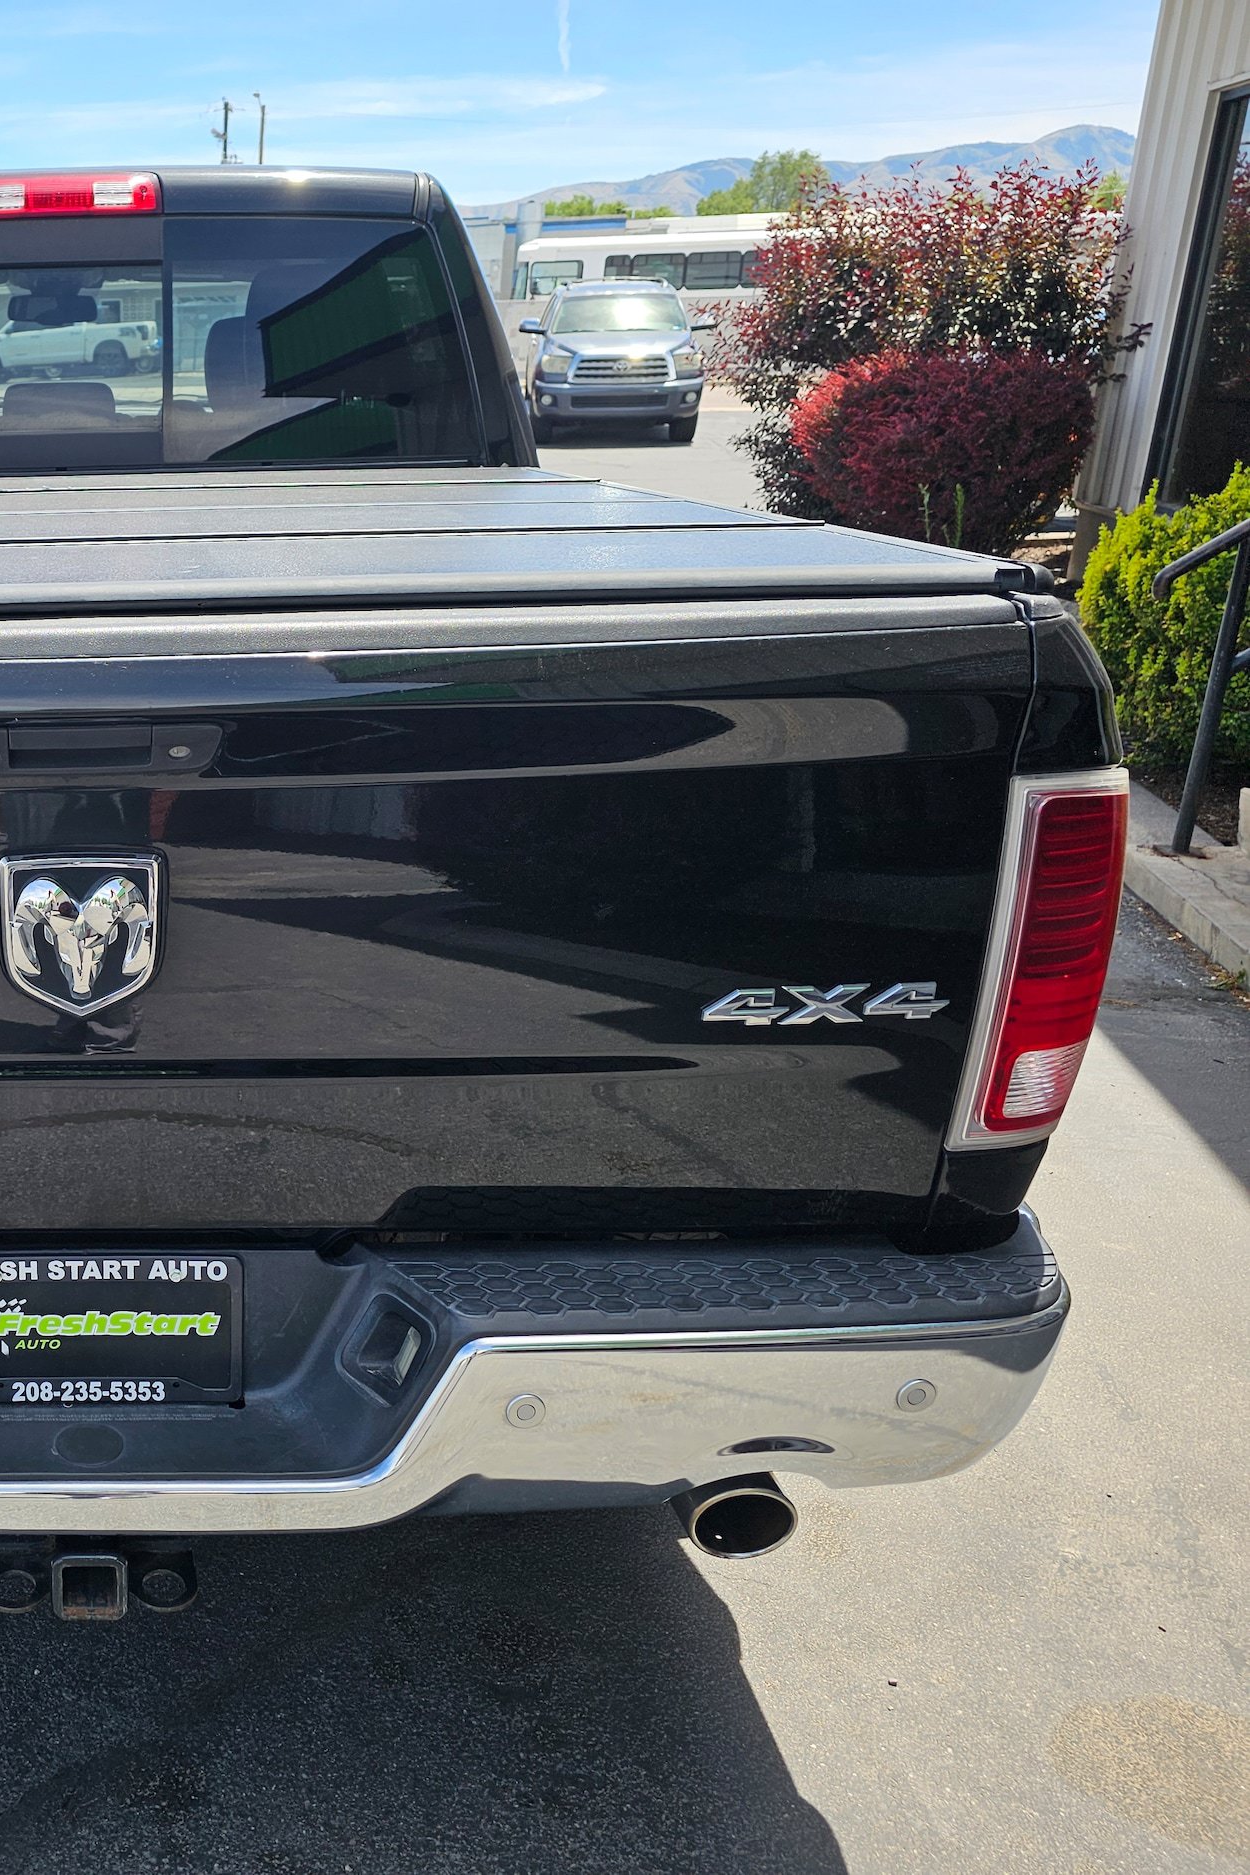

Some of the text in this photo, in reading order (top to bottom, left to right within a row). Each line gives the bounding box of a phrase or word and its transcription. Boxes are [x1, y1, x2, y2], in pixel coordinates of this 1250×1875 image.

[47, 1260, 140, 1281] START
[148, 1260, 228, 1282] AUTO
[15, 1339, 62, 1350] AUTO
[11, 1381, 166, 1403] 208-235-5353
